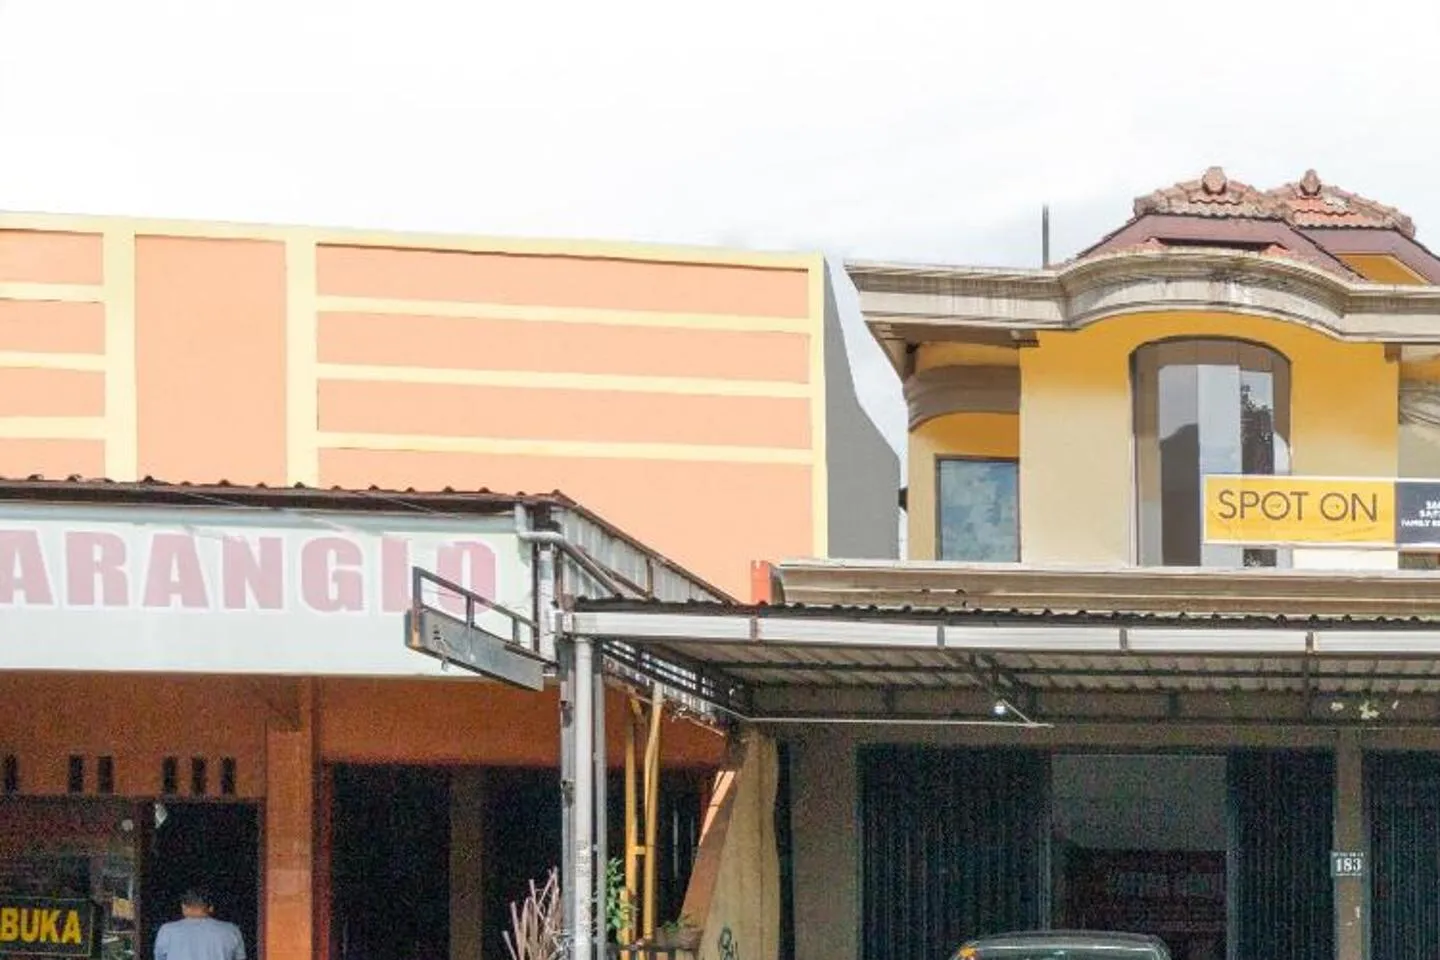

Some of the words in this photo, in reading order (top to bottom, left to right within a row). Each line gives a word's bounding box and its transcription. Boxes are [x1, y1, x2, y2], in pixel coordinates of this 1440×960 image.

[1218, 489, 1309, 521] SPOT
[1320, 492, 1377, 522] ON
[1336, 857, 1362, 873] 183
[1, 906, 82, 944] BUKA
